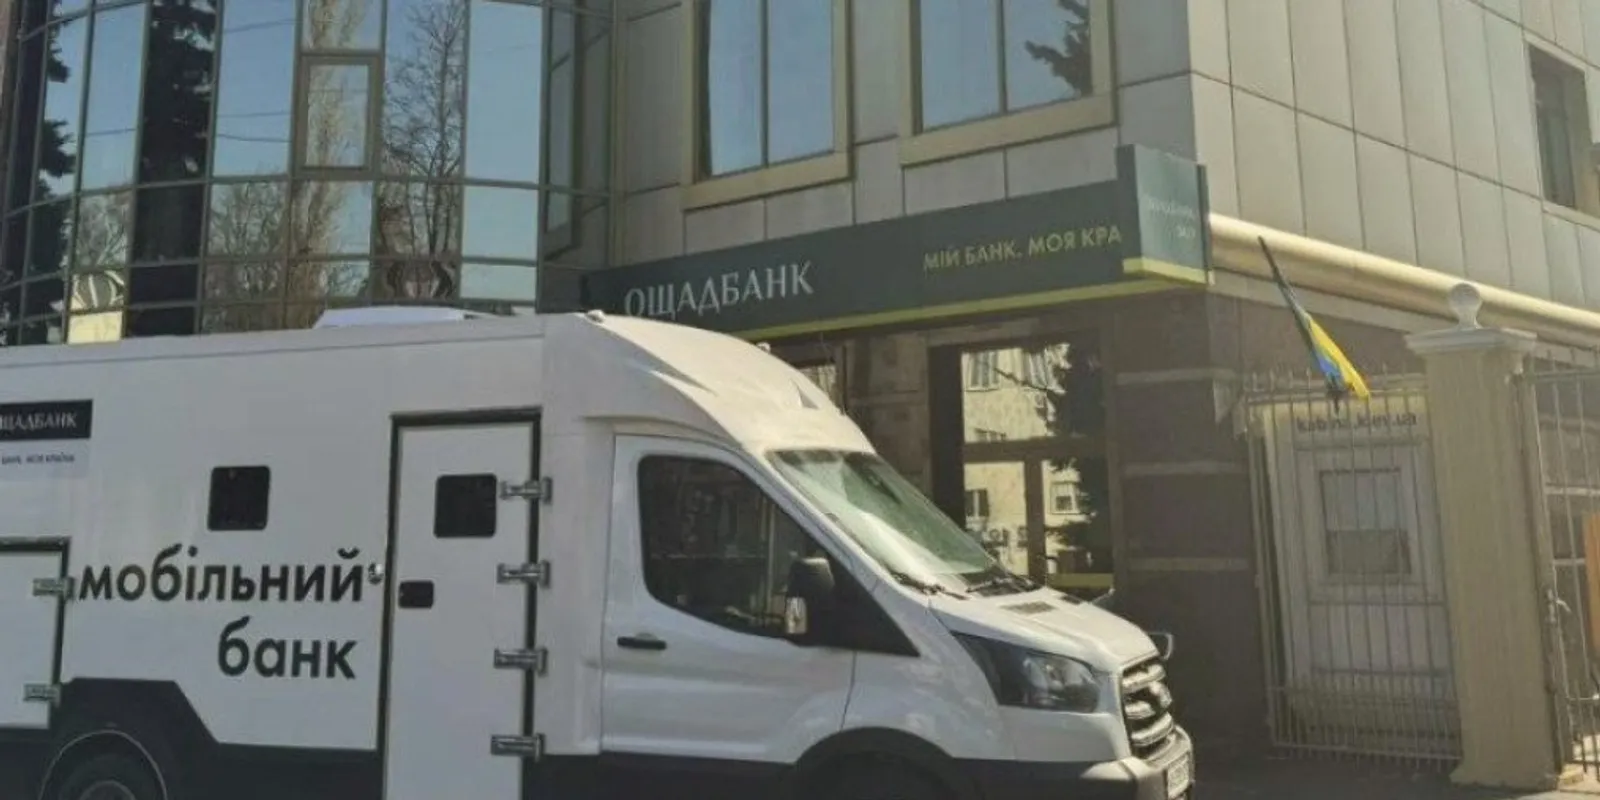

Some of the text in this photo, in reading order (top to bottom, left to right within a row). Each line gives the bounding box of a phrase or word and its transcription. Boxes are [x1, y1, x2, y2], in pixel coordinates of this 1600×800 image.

[1028, 231, 1076, 257] МОЯ
[1081, 224, 1122, 248] КРА
[624, 260, 815, 320] ОЩАДБАНК
[1296, 411, 1417, 433] kabna.kev.ua
[78, 543, 363, 601] мобільний
[217, 615, 358, 679] банк
